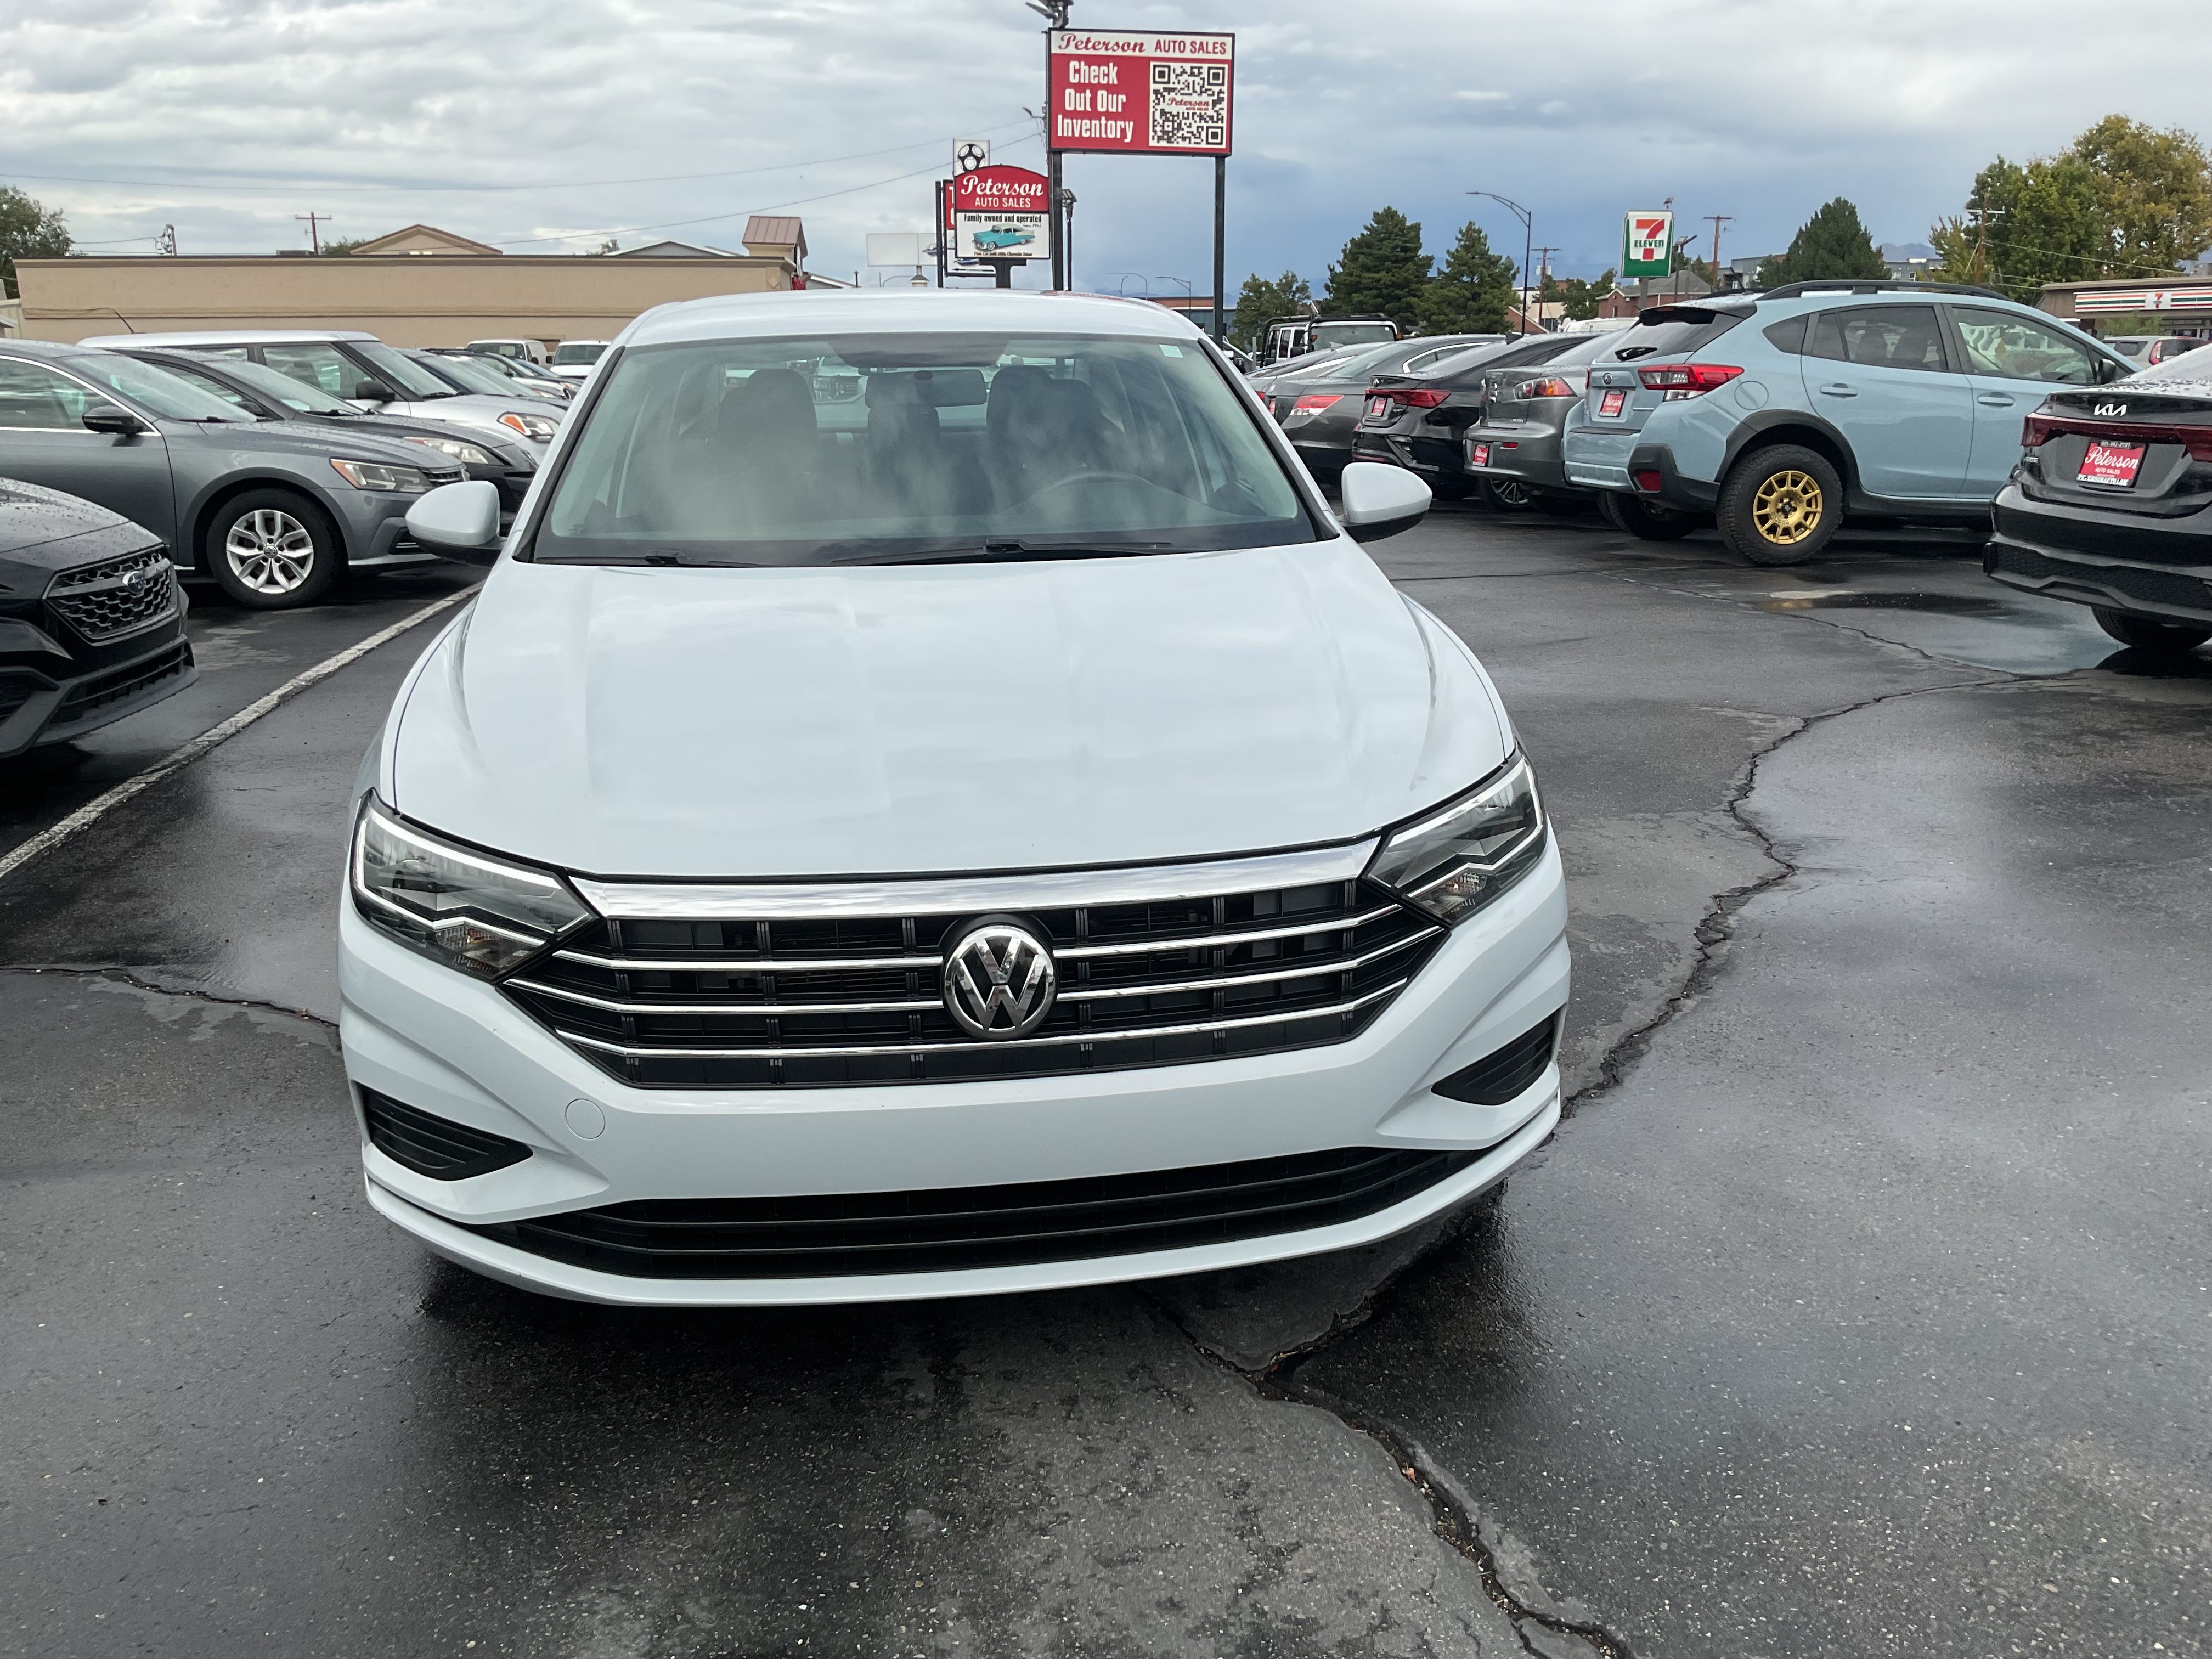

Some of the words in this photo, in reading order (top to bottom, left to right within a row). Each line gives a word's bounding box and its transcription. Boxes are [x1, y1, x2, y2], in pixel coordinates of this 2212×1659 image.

[1058, 33, 1146, 53] Peterson
[1155, 40, 1186, 53] AUTO
[1190, 41, 1226, 54] SALES
[1069, 61, 1118, 84] Check
[1065, 88, 1092, 111] Out
[1097, 90, 1126, 112] Our
[1167, 97, 1210, 106] Peterson
[1057, 115, 1133, 143] Inventory
[961, 175, 1043, 196] Peterson
[975, 197, 999, 207] AUTO
[1002, 198, 1031, 208] SALES
[964, 214, 982, 223] Family
[1017, 215, 1041, 223] operated
[1635, 218, 1665, 261] 7
[2094, 404, 2127, 416] KIA
[2085, 446, 2139, 469] Peterson
